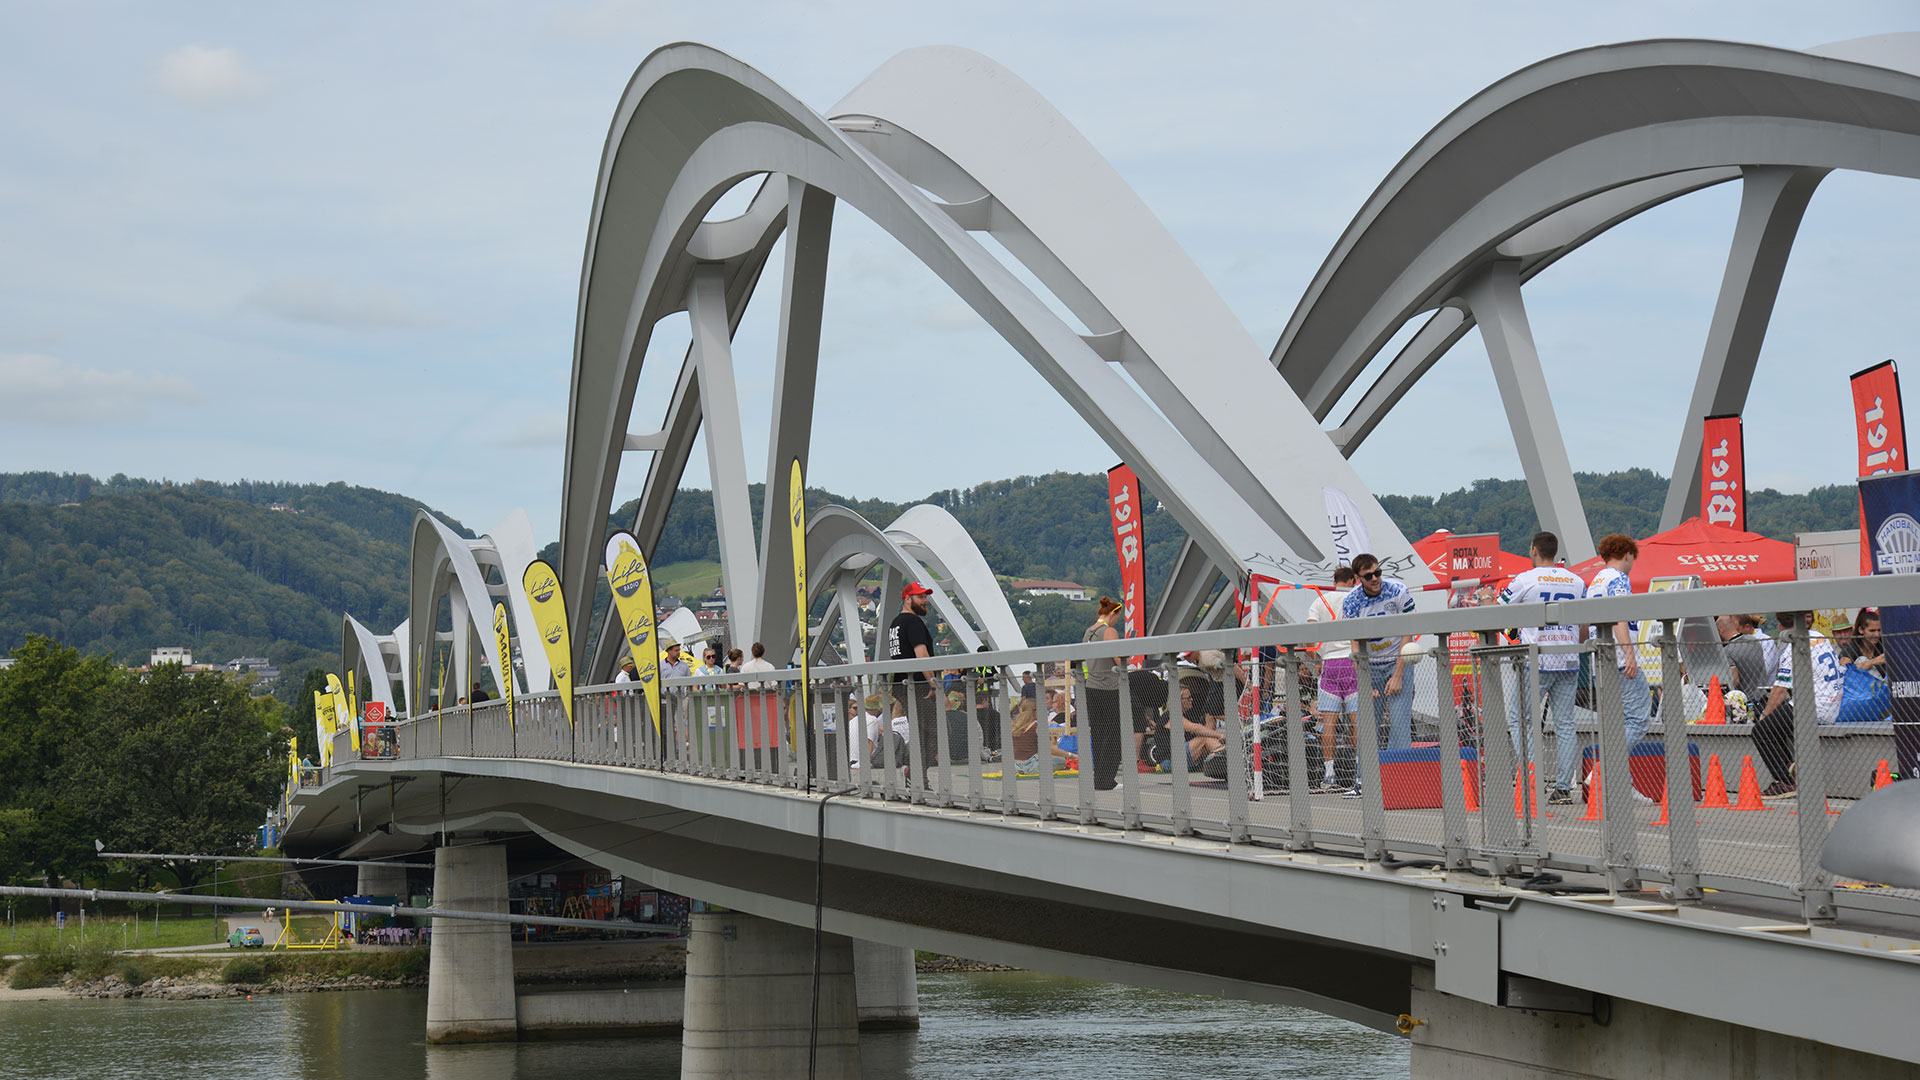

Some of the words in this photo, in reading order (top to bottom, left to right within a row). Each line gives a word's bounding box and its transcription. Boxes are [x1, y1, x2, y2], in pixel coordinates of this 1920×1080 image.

[1706, 437, 1738, 527] Bier
[1114, 484, 1138, 568] Bier
[1453, 547, 1478, 558] ROTAX
[1677, 554, 1759, 566] Linzer
[611, 558, 645, 584] Life
[1700, 563, 1748, 572] Bier
[531, 577, 556, 595] Life
[623, 581, 640, 591] RADIO
[627, 615, 653, 634] Life
[1651, 624, 1662, 634] WC
